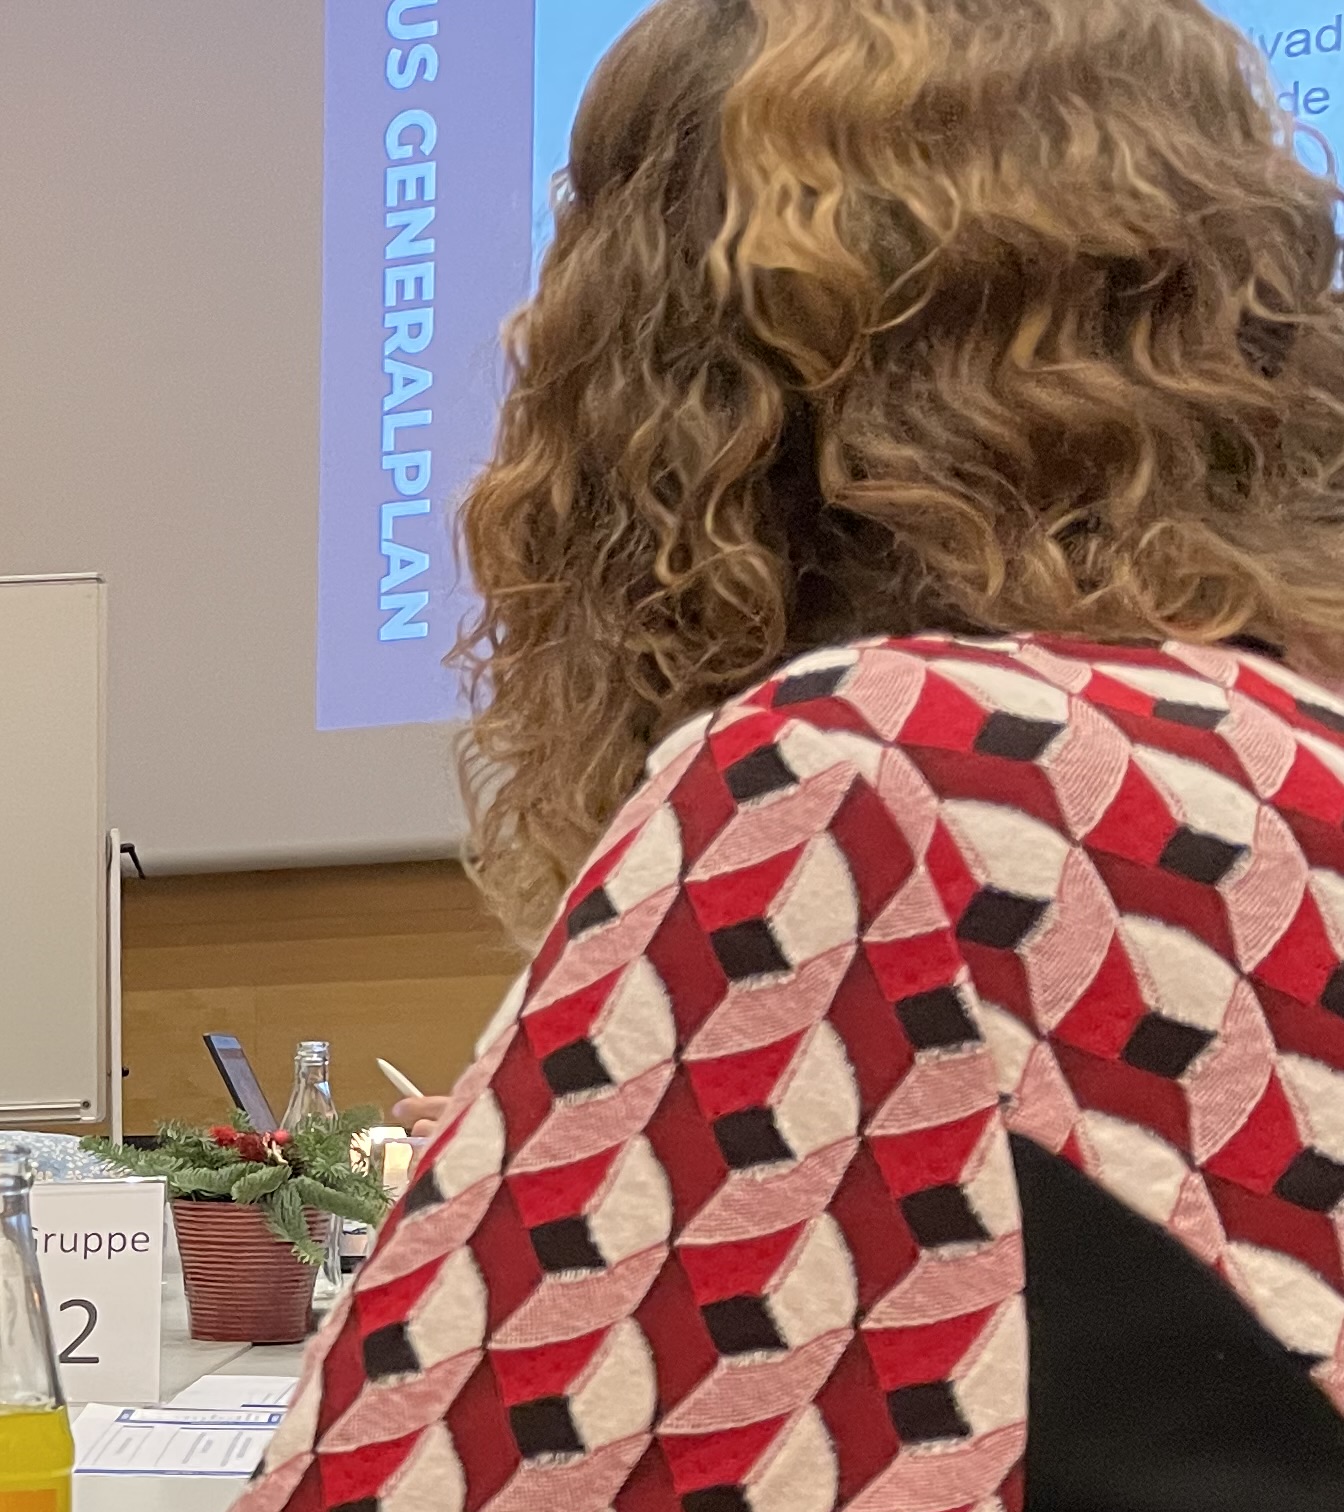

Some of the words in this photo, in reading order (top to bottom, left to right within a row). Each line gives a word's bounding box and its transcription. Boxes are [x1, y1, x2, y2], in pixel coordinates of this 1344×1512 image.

[386, 0, 439, 90] US
[1249, 13, 1342, 60] vad
[378, 108, 438, 643] GENERALPLAN
[32, 1226, 151, 1260] ruppe
[58, 1298, 100, 1364] 2
